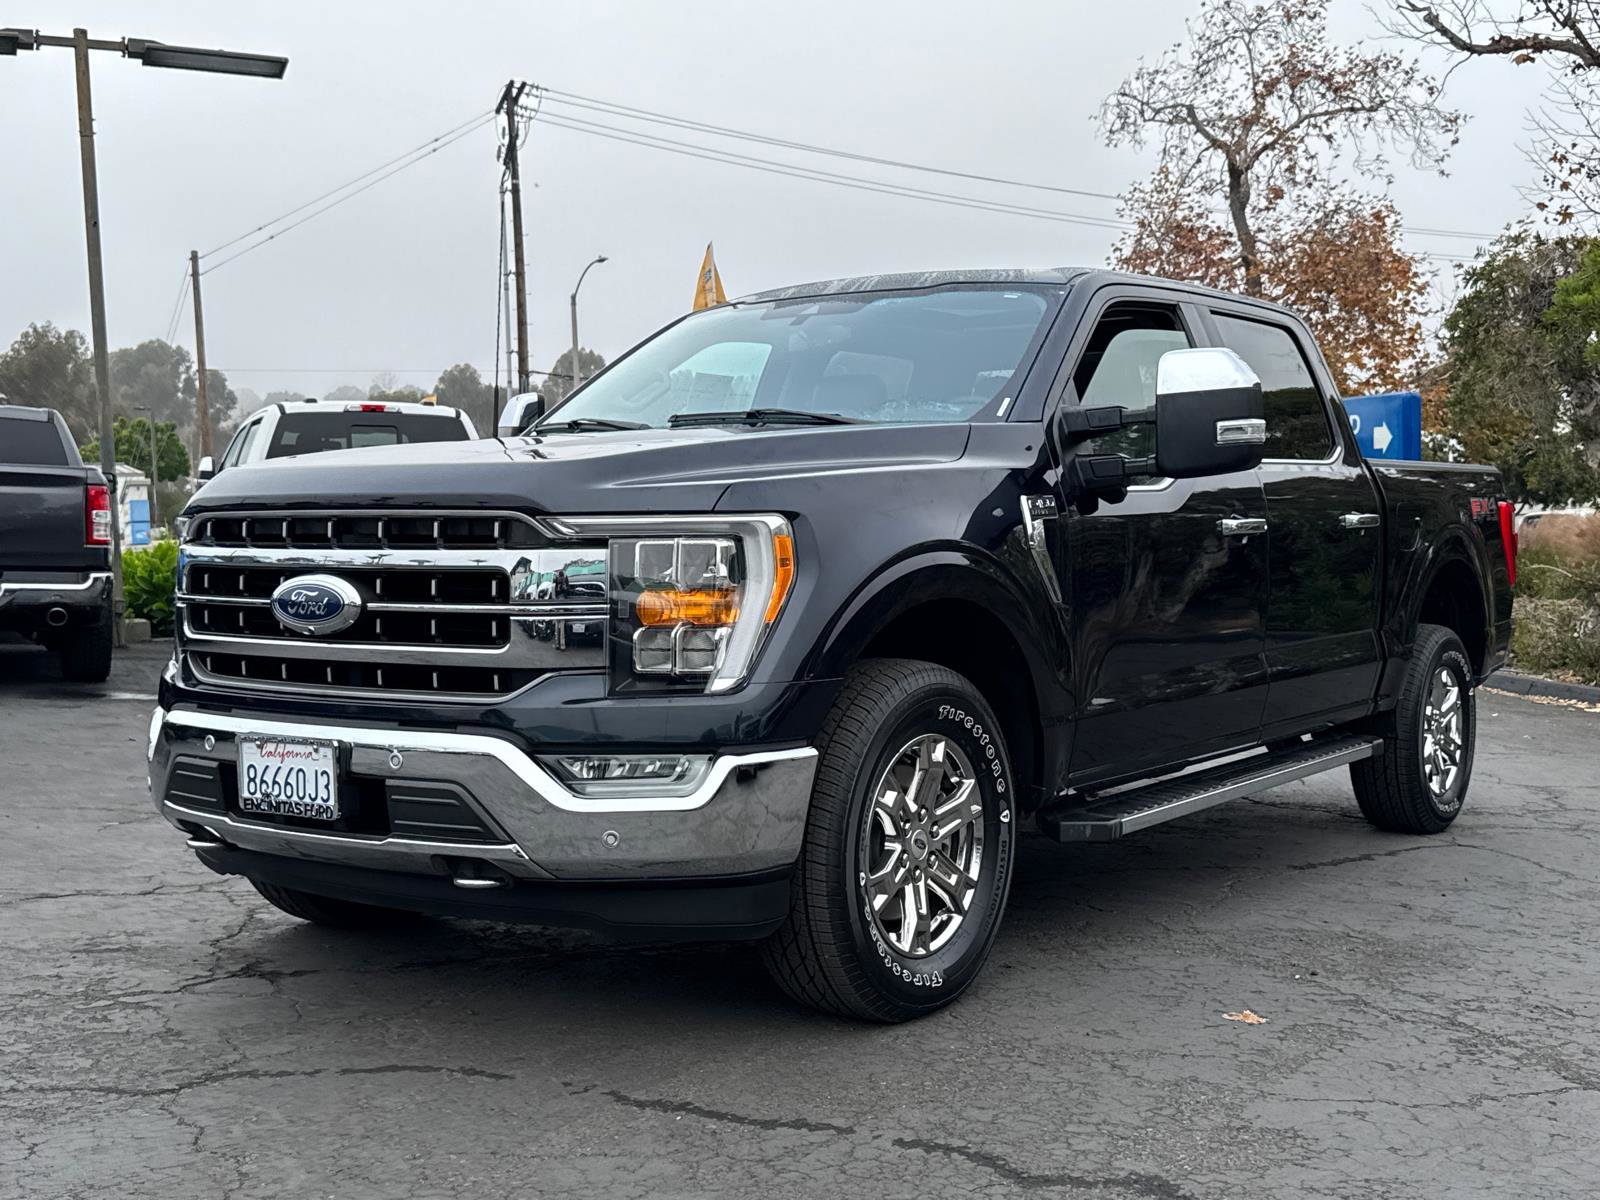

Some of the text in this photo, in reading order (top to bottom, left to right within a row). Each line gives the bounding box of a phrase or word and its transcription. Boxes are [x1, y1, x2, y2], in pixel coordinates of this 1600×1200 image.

[1470, 496, 1498, 520] FX4
[287, 589, 329, 615] Ford
[260, 740, 313, 765] California
[938, 705, 1006, 793] Firestone
[246, 763, 331, 804] 86660J3
[243, 797, 335, 820] ENCINITAS FORD
